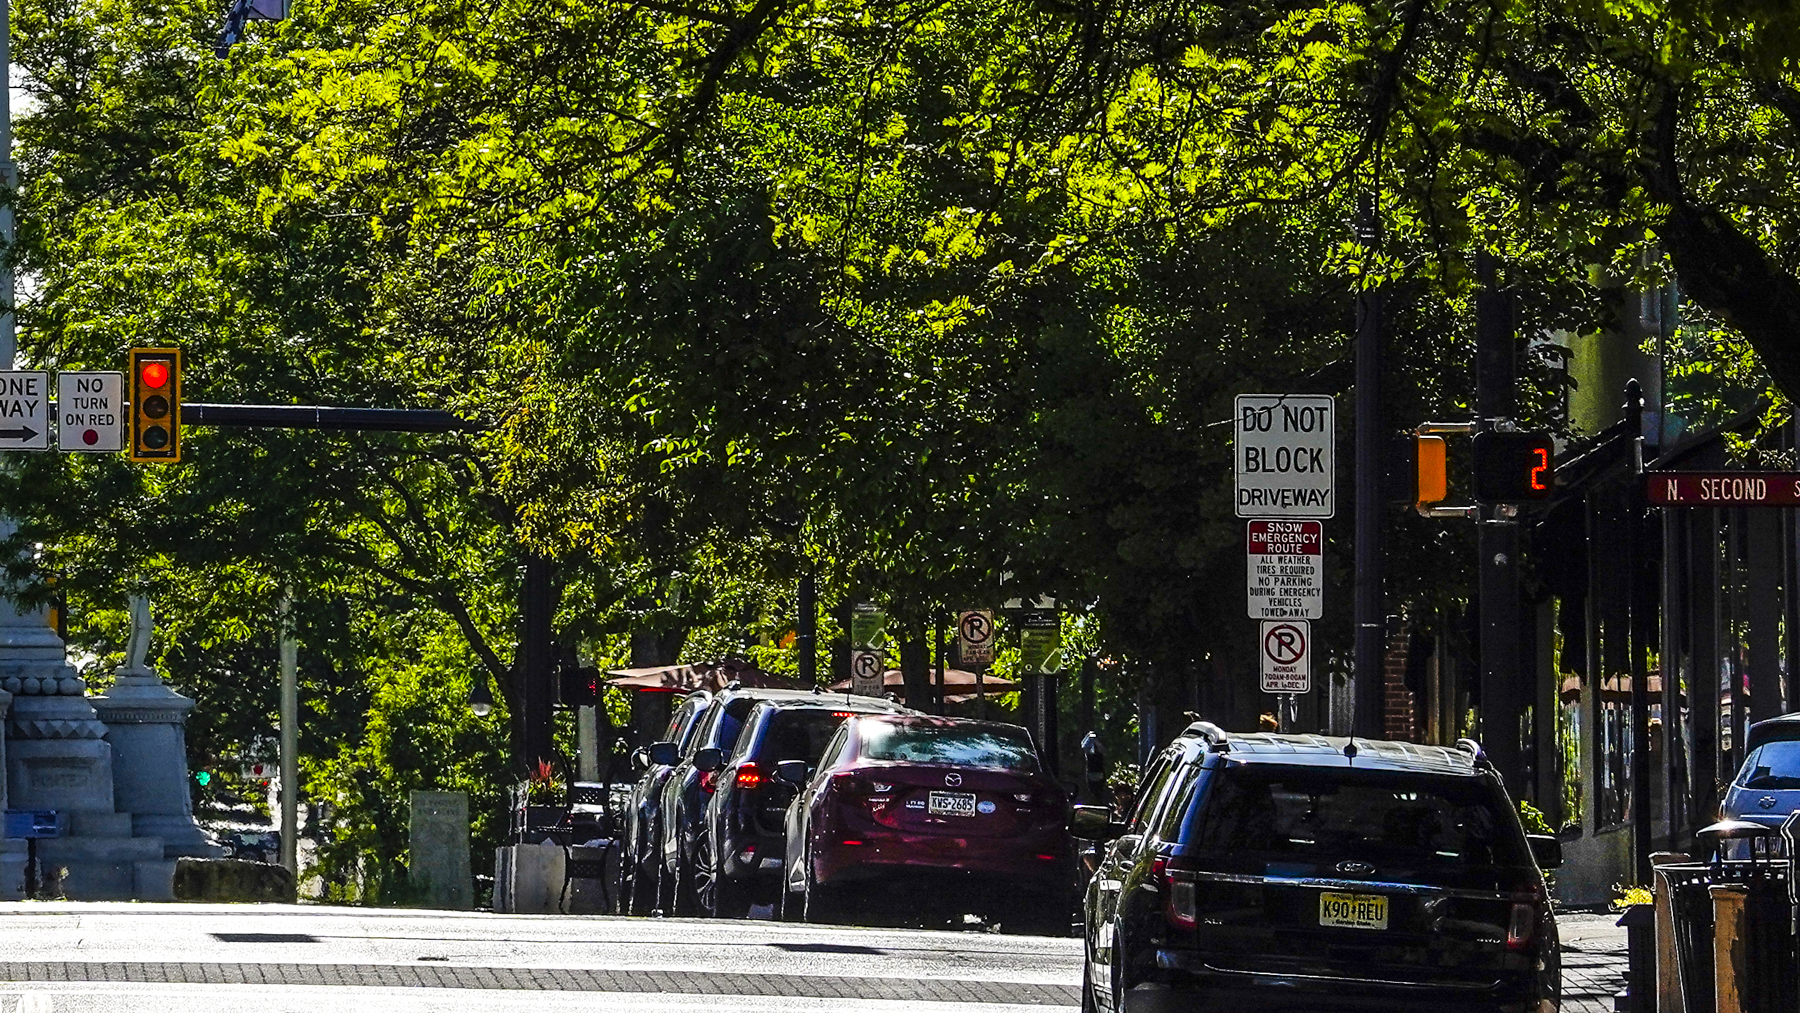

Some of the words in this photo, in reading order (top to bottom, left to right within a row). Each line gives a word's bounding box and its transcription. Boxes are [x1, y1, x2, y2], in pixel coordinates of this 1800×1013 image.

[77, 378, 103, 393] NO
[73, 397, 108, 409] TURN
[65, 414, 84, 426] ON
[89, 414, 115, 426] RED
[1243, 406, 1272, 432] DO
[1282, 404, 1328, 433] NOT
[1245, 446, 1324, 473] BLOCK
[1531, 448, 1547, 490] 2
[1667, 478, 1684, 501] N.
[1700, 477, 1767, 501] SECOND
[1239, 488, 1330, 507] DRIVEWAY
[1267, 523, 1303, 533] SNOW
[1252, 533, 1317, 543] EMERGENCY
[1267, 544, 1303, 553] ROUTE
[1260, 556, 1274, 565] ALL
[1277, 556, 1311, 565] WEATHER
[1256, 566, 1276, 575] TIRES
[1279, 566, 1315, 575] REQUIRED
[1258, 577, 1270, 586] NO
[1274, 577, 1313, 587] PARKING
[1249, 588, 1276, 597] DURING
[1279, 588, 1321, 597] EMERGENCY
[1268, 598, 1302, 607] VEHICLES
[1261, 608, 1285, 617] TOWED
[1288, 608, 1310, 617] AWAY
